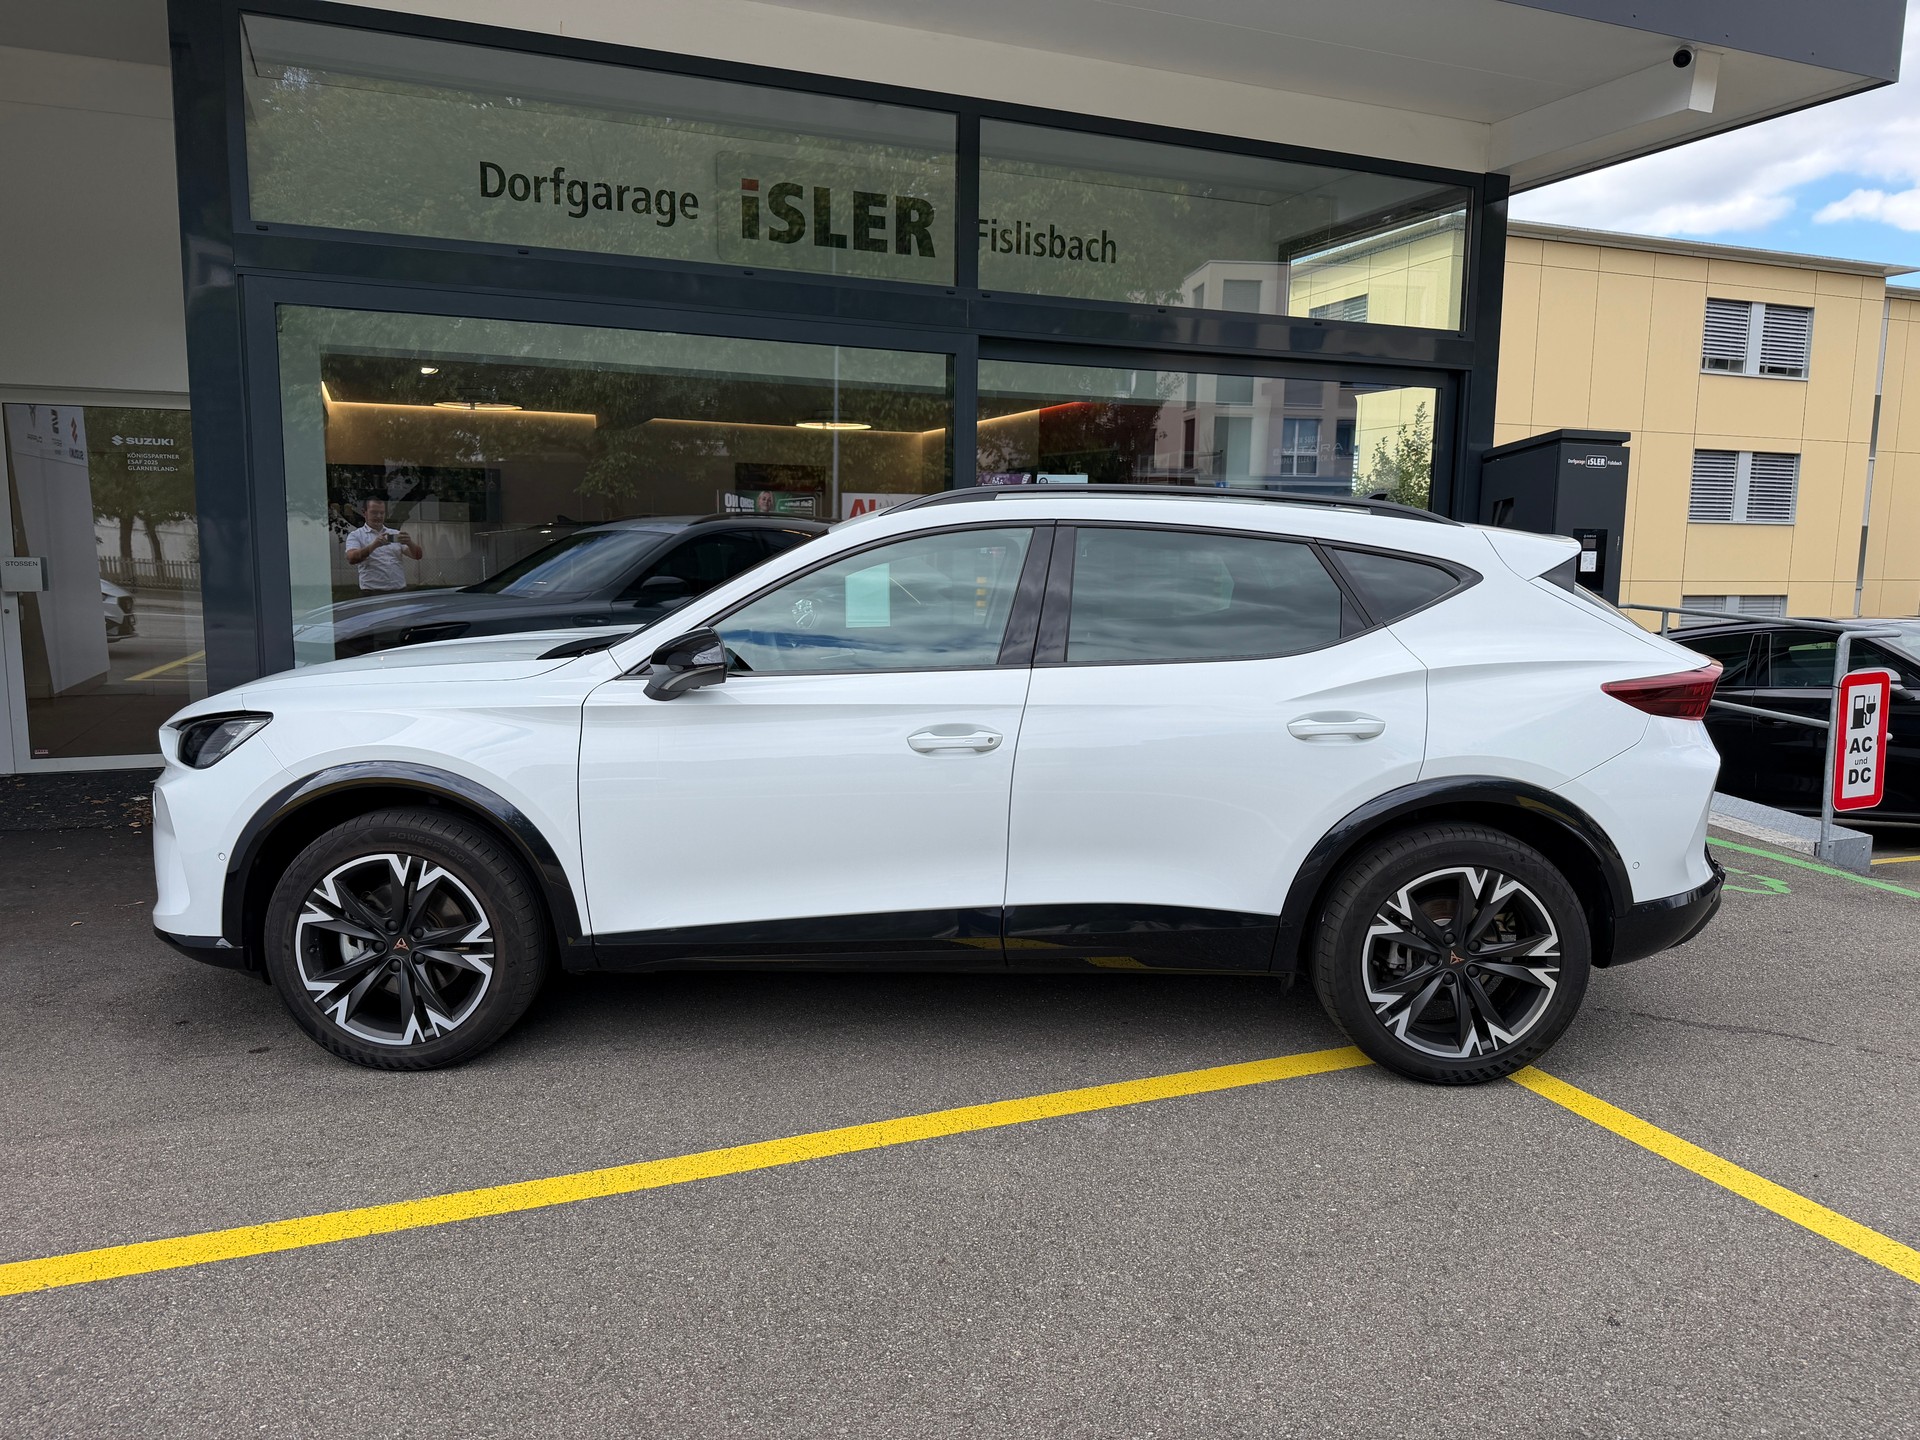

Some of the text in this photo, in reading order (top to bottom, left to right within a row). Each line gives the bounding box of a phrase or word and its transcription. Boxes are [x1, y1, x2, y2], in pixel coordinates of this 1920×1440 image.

[479, 161, 699, 227] Dorfgarage
[741, 178, 935, 258] iSLER
[125, 436, 174, 446] SUZUKI
[1282, 442, 1344, 455] VTARA
[1849, 736, 1873, 754] AC
[1854, 756, 1868, 766] und
[1848, 767, 1871, 785] DC
